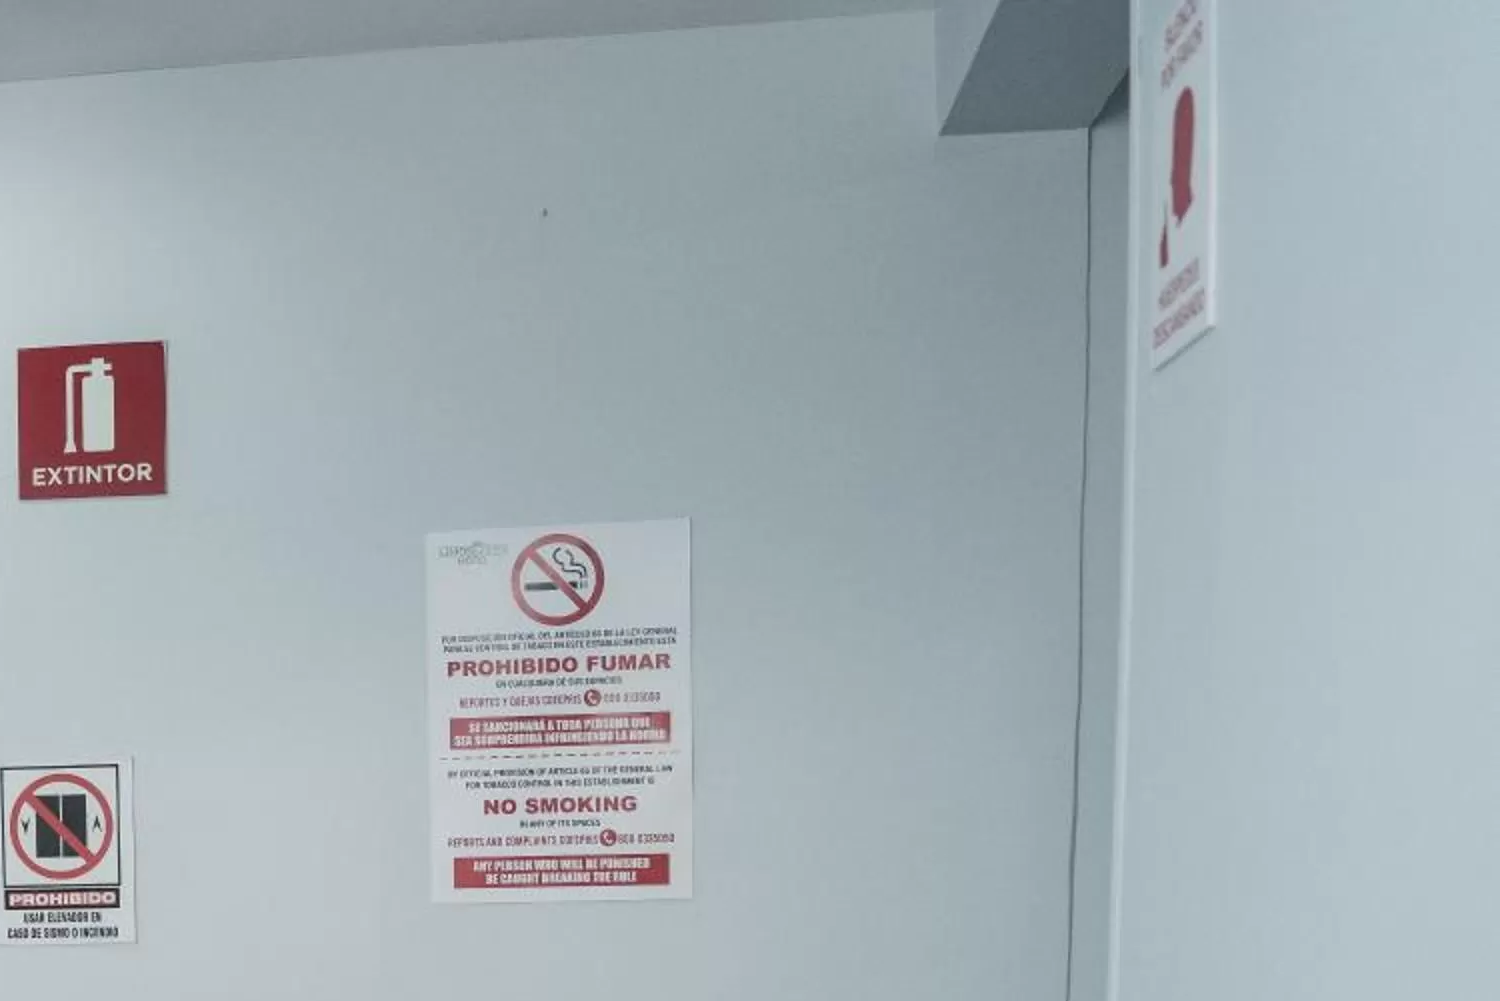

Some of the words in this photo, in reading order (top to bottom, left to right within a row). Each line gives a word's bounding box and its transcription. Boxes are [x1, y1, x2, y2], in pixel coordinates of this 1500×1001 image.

[32, 463, 153, 487] EXTINTOR
[447, 657, 579, 678] PROHIBIDO
[586, 653, 671, 673] FUMAR
[483, 799, 517, 816] NO
[525, 795, 638, 814] SMOKING
[9, 891, 116, 907] PROHIBIDO
[7, 927, 29, 939] CASO
[31, 927, 42, 938] DE
